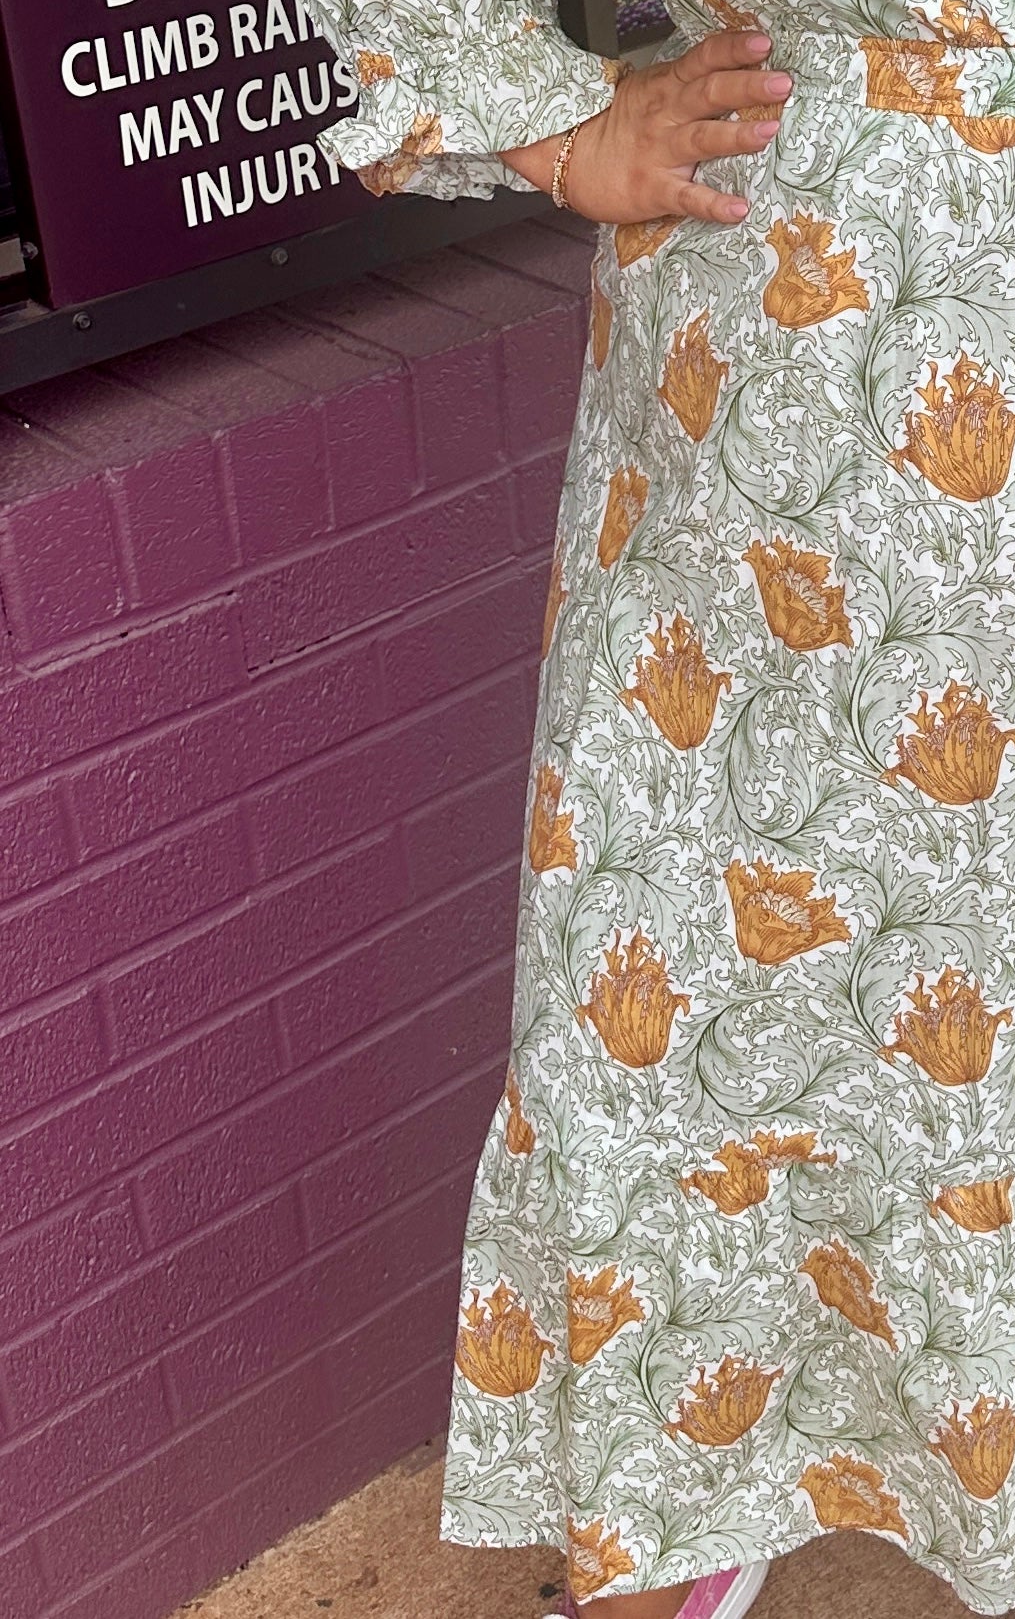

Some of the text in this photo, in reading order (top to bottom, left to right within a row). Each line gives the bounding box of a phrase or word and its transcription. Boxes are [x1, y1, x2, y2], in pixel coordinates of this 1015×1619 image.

[60, 12, 220, 97] CLIMB
[118, 59, 360, 167] MAY CAUS
